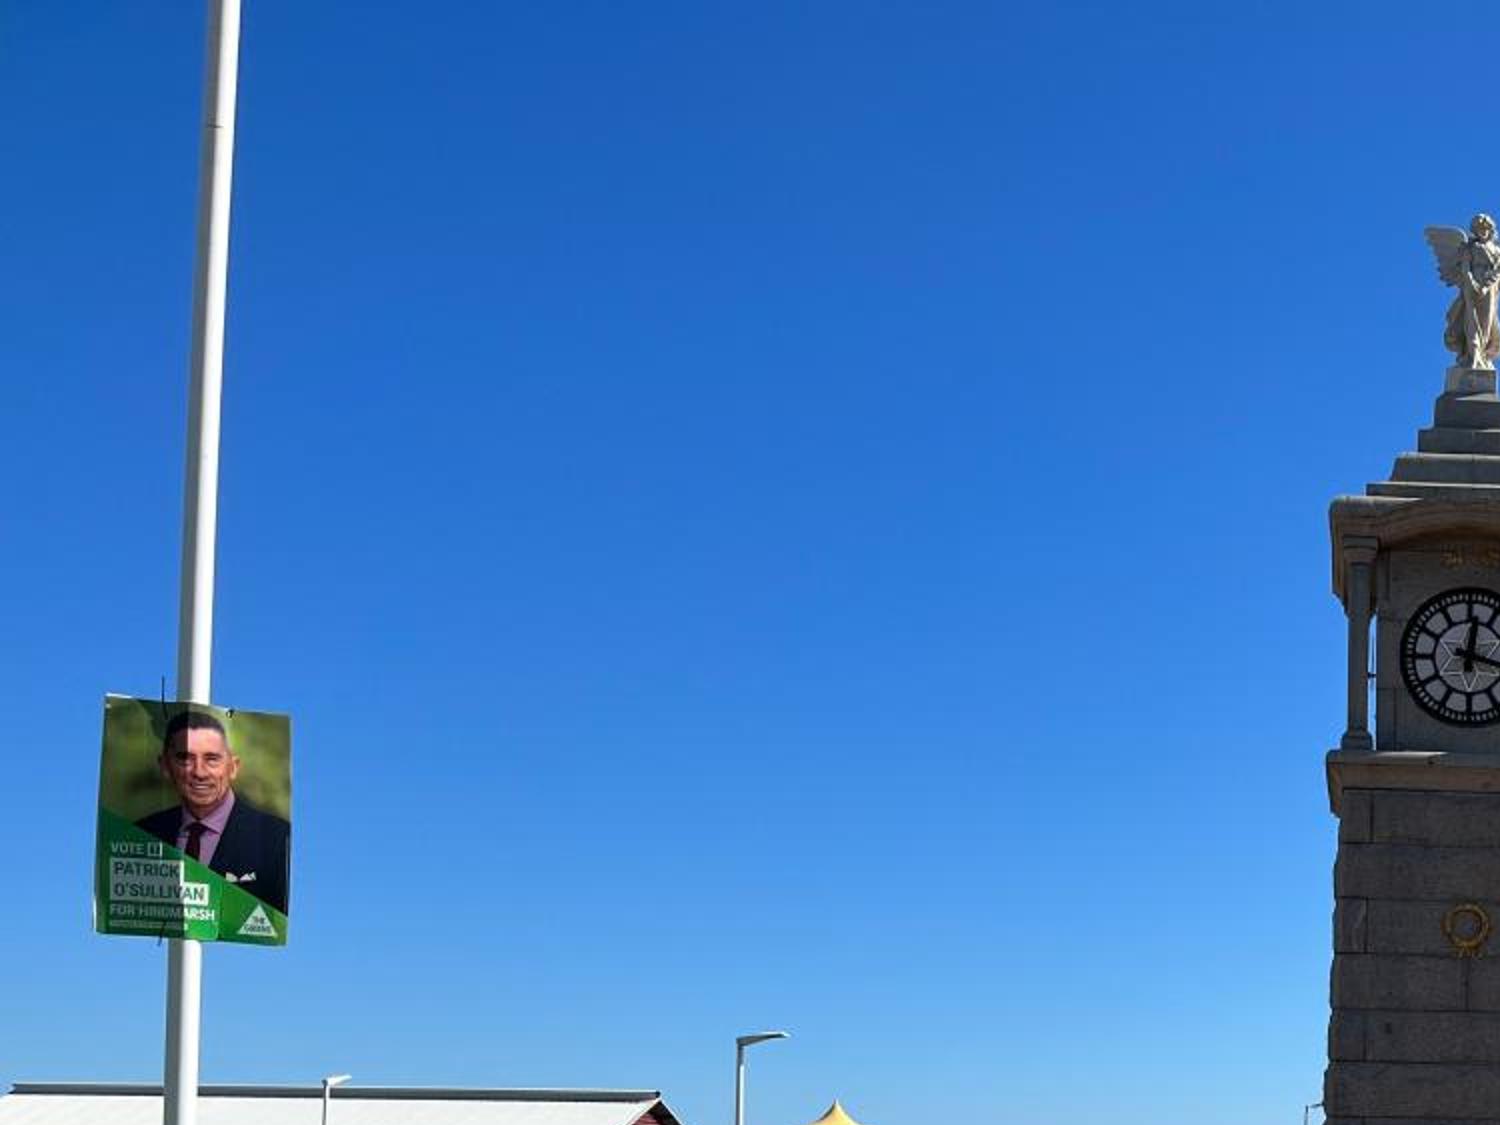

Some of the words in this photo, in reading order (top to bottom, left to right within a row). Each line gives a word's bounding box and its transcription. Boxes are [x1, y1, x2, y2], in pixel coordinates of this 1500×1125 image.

[111, 842, 145, 855] VOTE
[113, 861, 180, 878] PATRICK
[114, 882, 205, 901] O'SULLIVAN
[110, 904, 135, 917] FOR
